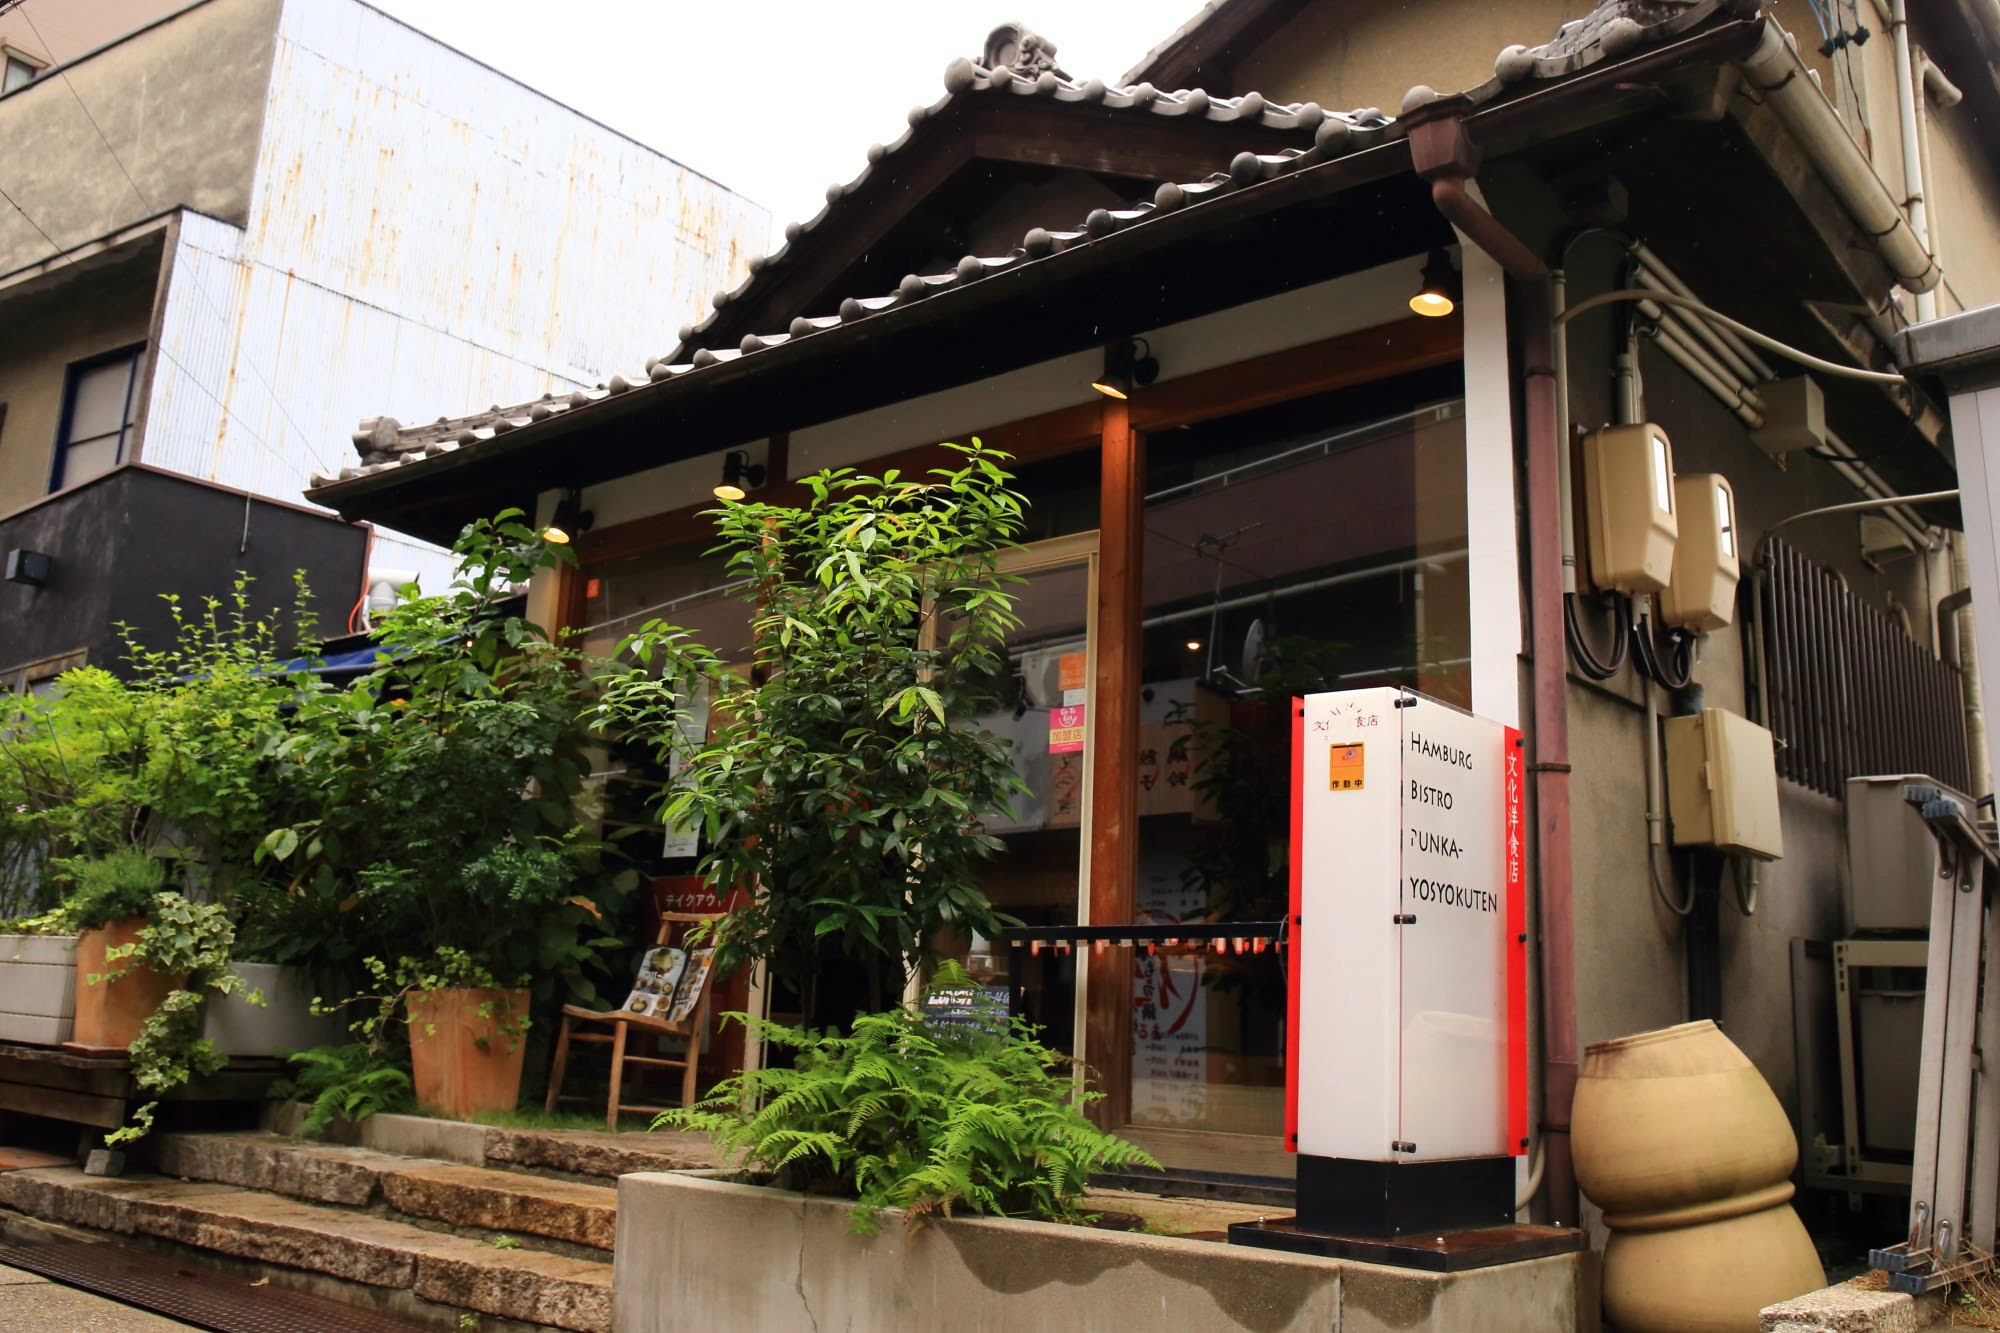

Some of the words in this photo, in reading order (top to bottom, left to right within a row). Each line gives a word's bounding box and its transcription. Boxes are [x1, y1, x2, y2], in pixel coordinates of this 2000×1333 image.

[1053, 730, 1082, 742] 加盟店
[1411, 731, 1472, 770] HAMBURG
[1332, 779, 1362, 789] 作動中
[1411, 779, 1453, 810] BISTRO
[1507, 752, 1519, 883] 文化洋食店
[1409, 876, 1497, 913] YOSYOKUTEN
